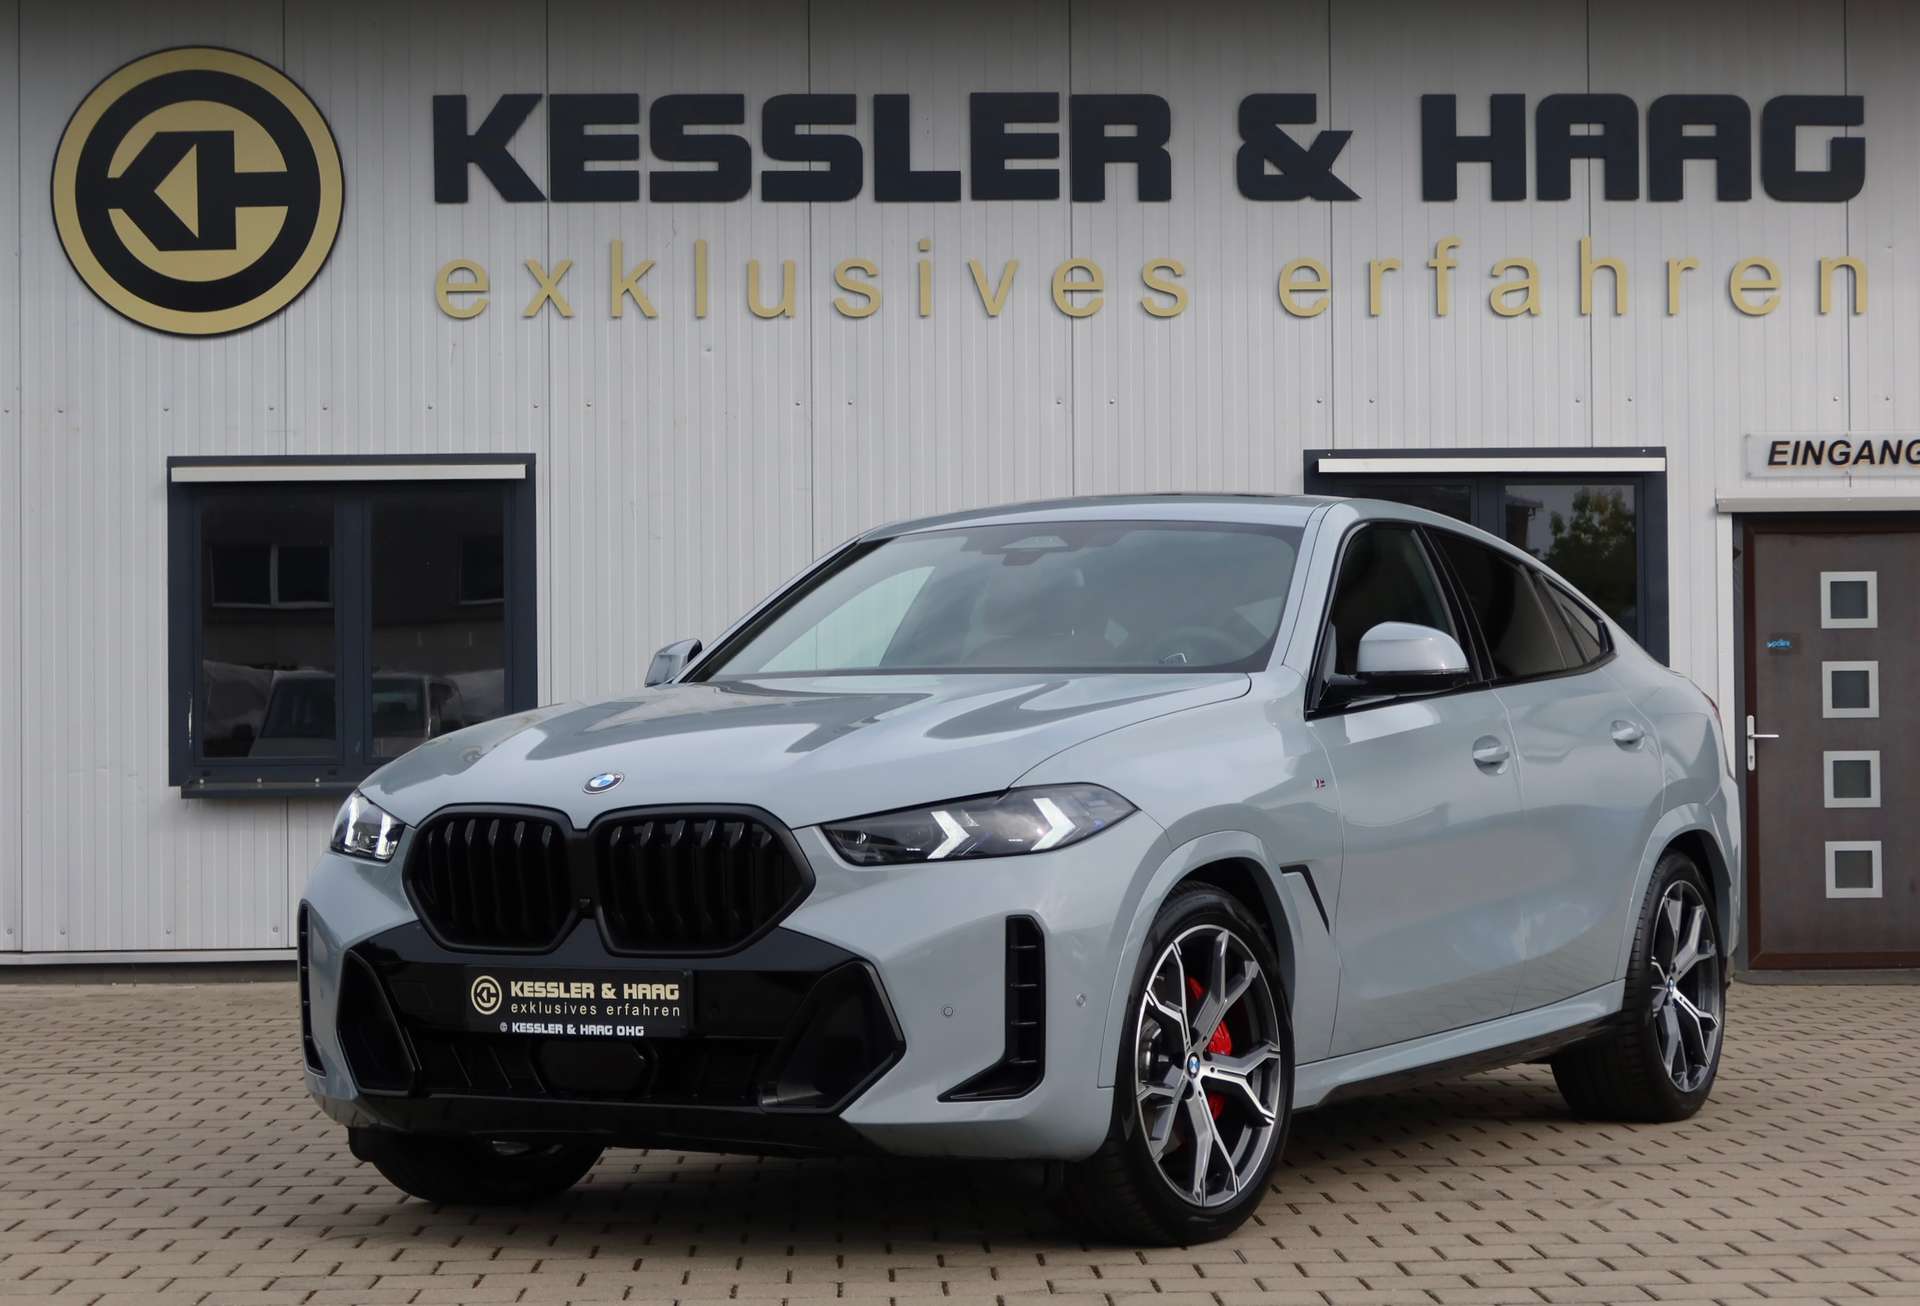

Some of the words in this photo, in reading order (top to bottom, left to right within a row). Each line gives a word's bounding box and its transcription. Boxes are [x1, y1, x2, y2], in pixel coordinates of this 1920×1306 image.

[433, 92, 1171, 203] KESSLER
[1237, 93, 1363, 202] &
[1421, 94, 1866, 202] HAAG
[435, 239, 1189, 319] exklusives
[1278, 236, 1869, 318] erfahren
[1767, 439, 1920, 466] EINGANG
[510, 981, 595, 999] KESSLER
[601, 982, 617, 1000] &
[623, 983, 680, 1001] HAAG
[511, 1001, 597, 1016] exklusives
[606, 1003, 681, 1018] erfahren
[511, 1022, 563, 1035] KESSLER
[566, 1024, 577, 1035] &
[580, 1025, 613, 1036] HAAG
[616, 1026, 645, 1037] OHG
